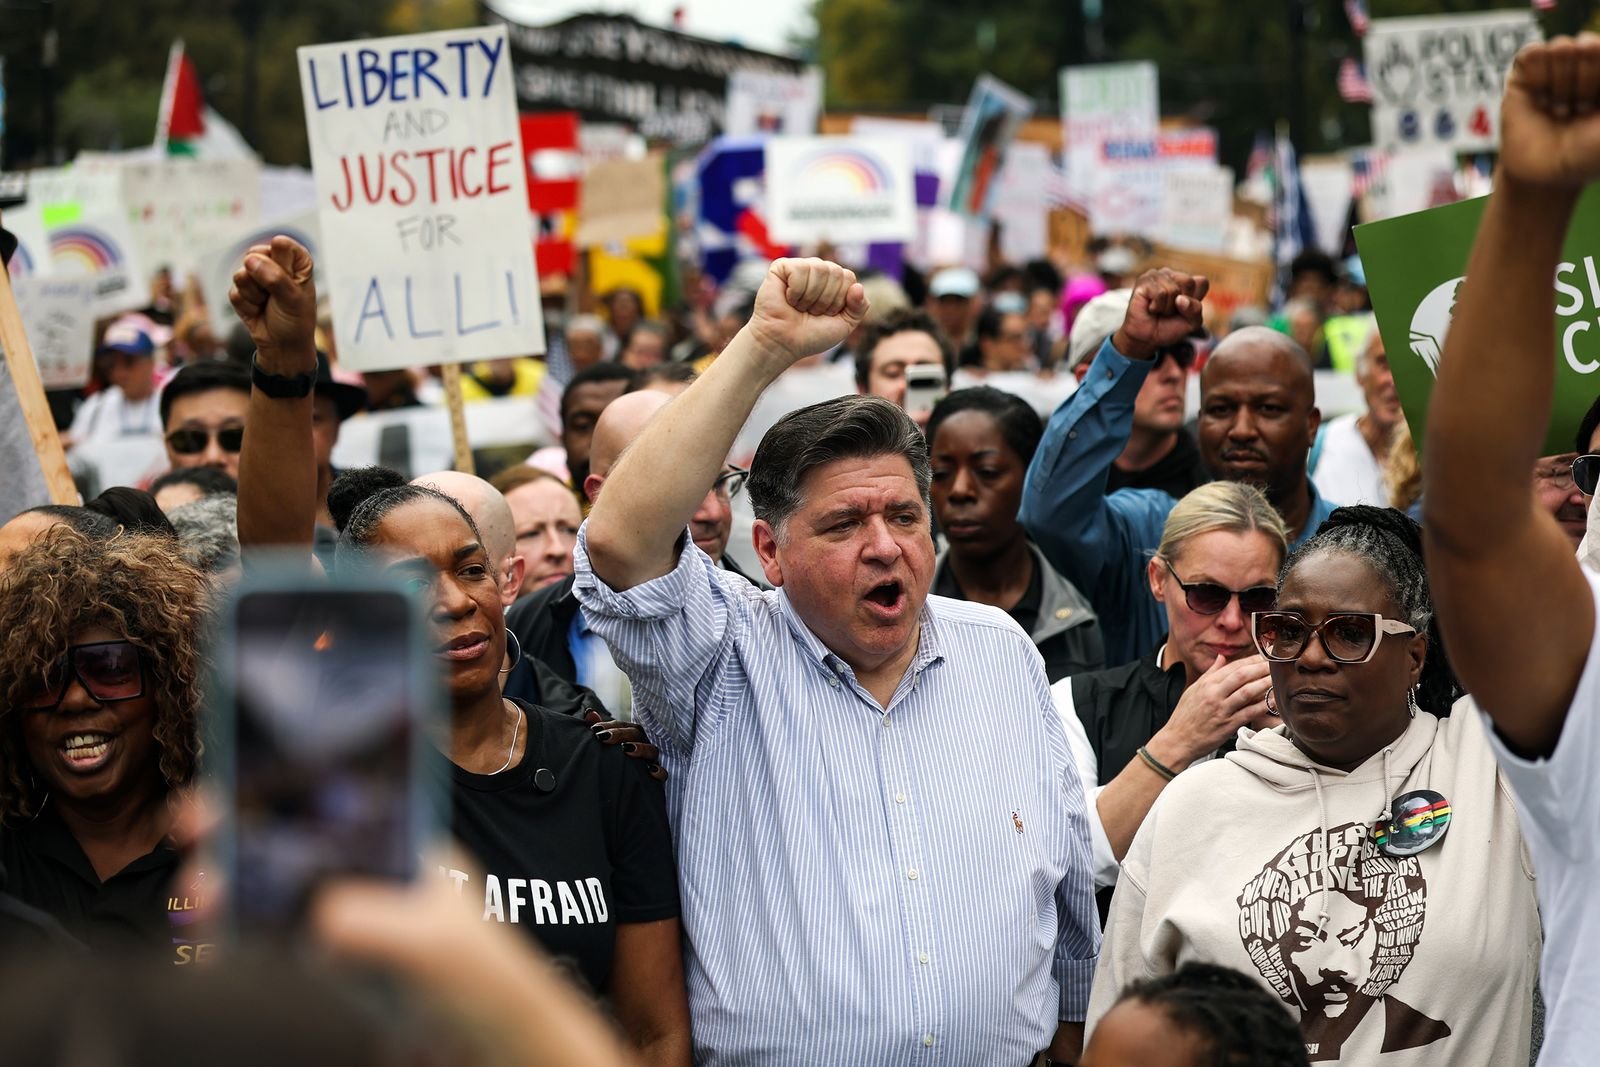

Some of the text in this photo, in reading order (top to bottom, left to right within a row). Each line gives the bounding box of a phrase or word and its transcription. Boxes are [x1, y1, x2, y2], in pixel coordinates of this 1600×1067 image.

[308, 36, 504, 111] LIBERTY
[383, 108, 450, 144] AND
[331, 140, 514, 213] JUSTICE
[397, 214, 462, 254] FOR
[1563, 316, 1600, 374] C
[1277, 825, 1367, 867] KEEP
[1277, 845, 1361, 881] HOPE
[482, 873, 609, 925] AFRAID
[1241, 867, 1290, 906] NEVER
[1290, 865, 1363, 906] ALIVE
[1362, 875, 1385, 898] THE
[1239, 899, 1292, 942] GIVE UP
[1378, 931, 1395, 948] AND
[1383, 913, 1423, 931] BLACK
[1266, 943, 1289, 979] NEVER
[1378, 945, 1411, 957] WE'RE ALL
[1376, 964, 1403, 981] GOD'S
